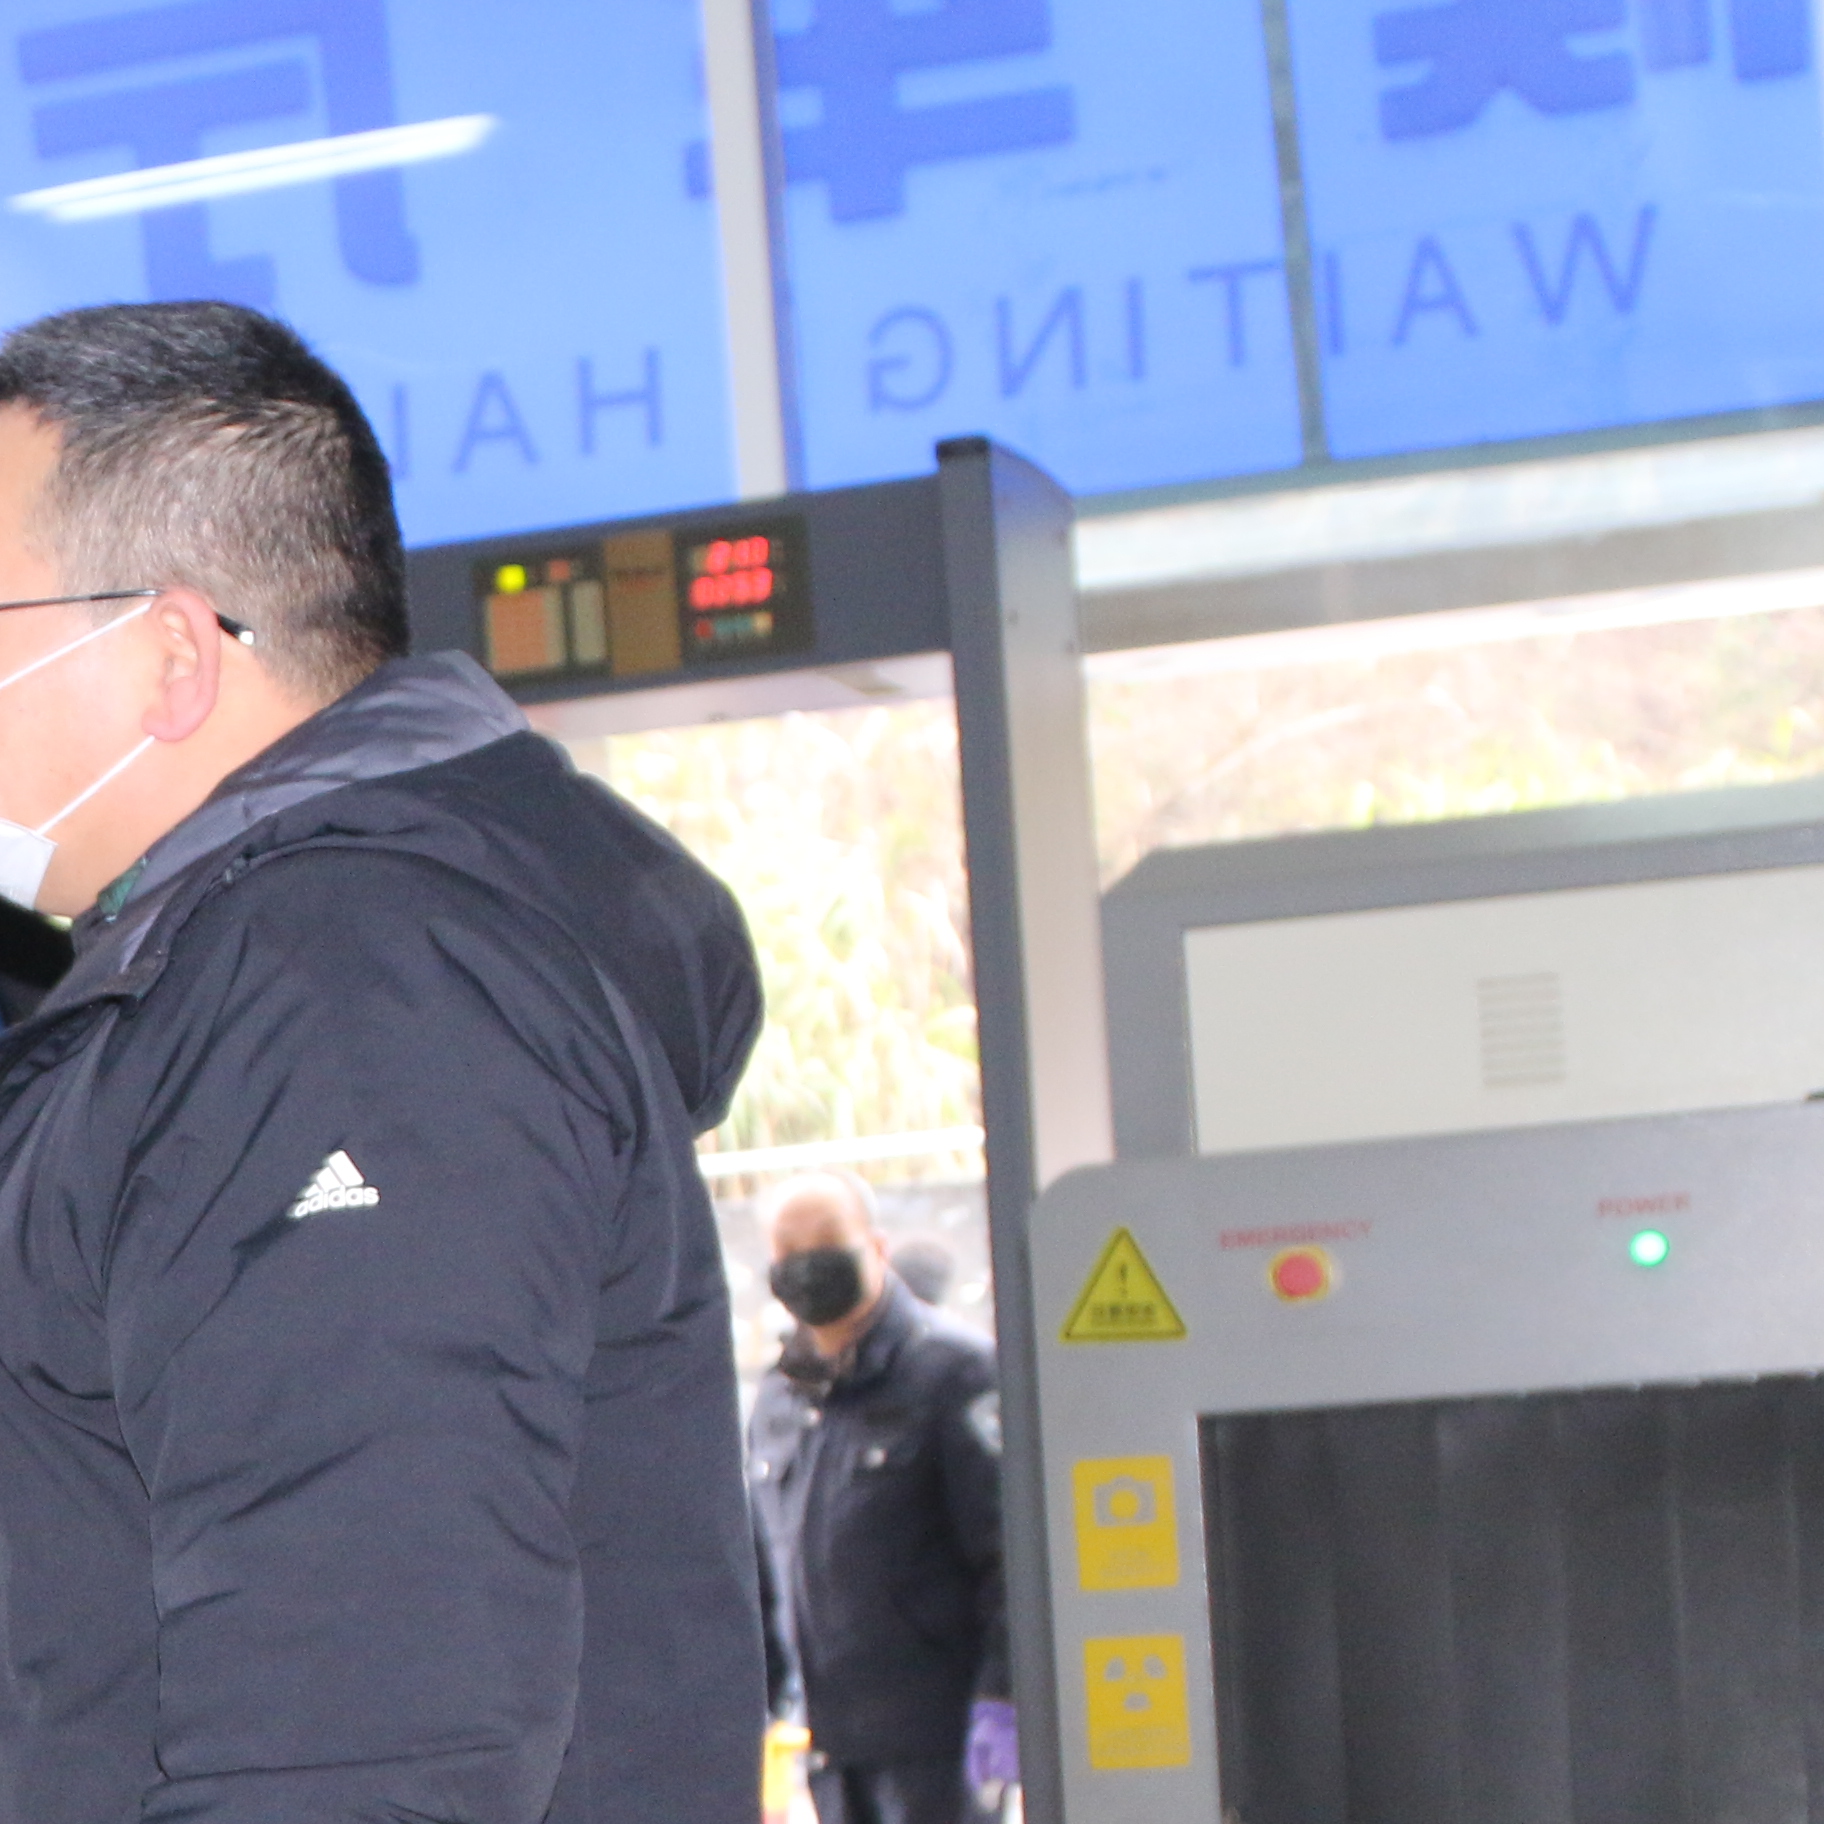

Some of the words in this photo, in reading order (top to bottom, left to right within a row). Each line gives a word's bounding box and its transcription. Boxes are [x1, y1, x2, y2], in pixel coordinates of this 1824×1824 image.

[292, 1185, 381, 1219] adidas
[1595, 1191, 1690, 1218] POWER
[1218, 1218, 1372, 1249] EMERGENCY
